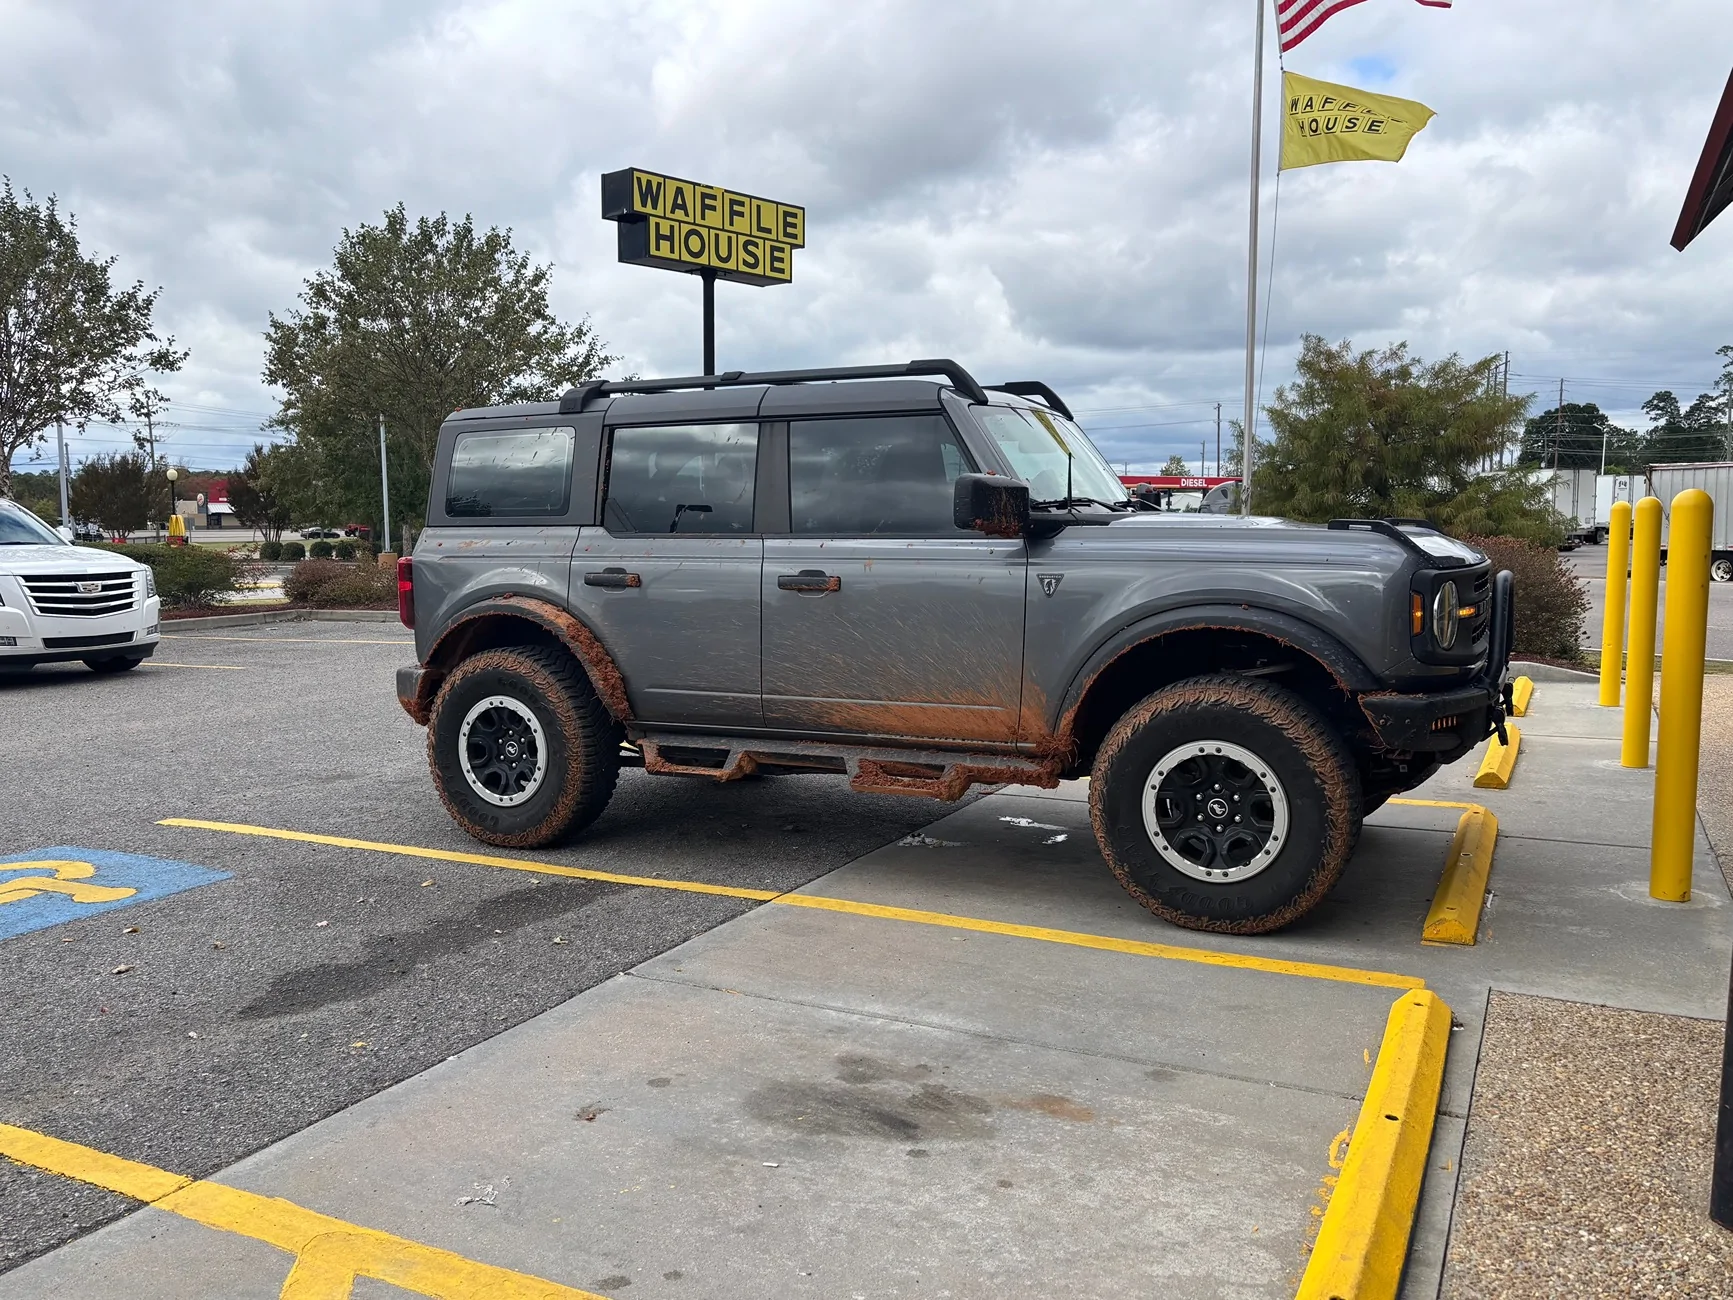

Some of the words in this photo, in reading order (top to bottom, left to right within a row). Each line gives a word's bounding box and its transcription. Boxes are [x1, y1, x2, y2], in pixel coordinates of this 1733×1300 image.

[1299, 116, 1384, 135] HOUSE
[636, 176, 798, 240] WAFFLE
[655, 222, 785, 275] HOUSE
[1181, 478, 1207, 487] DIESEL
